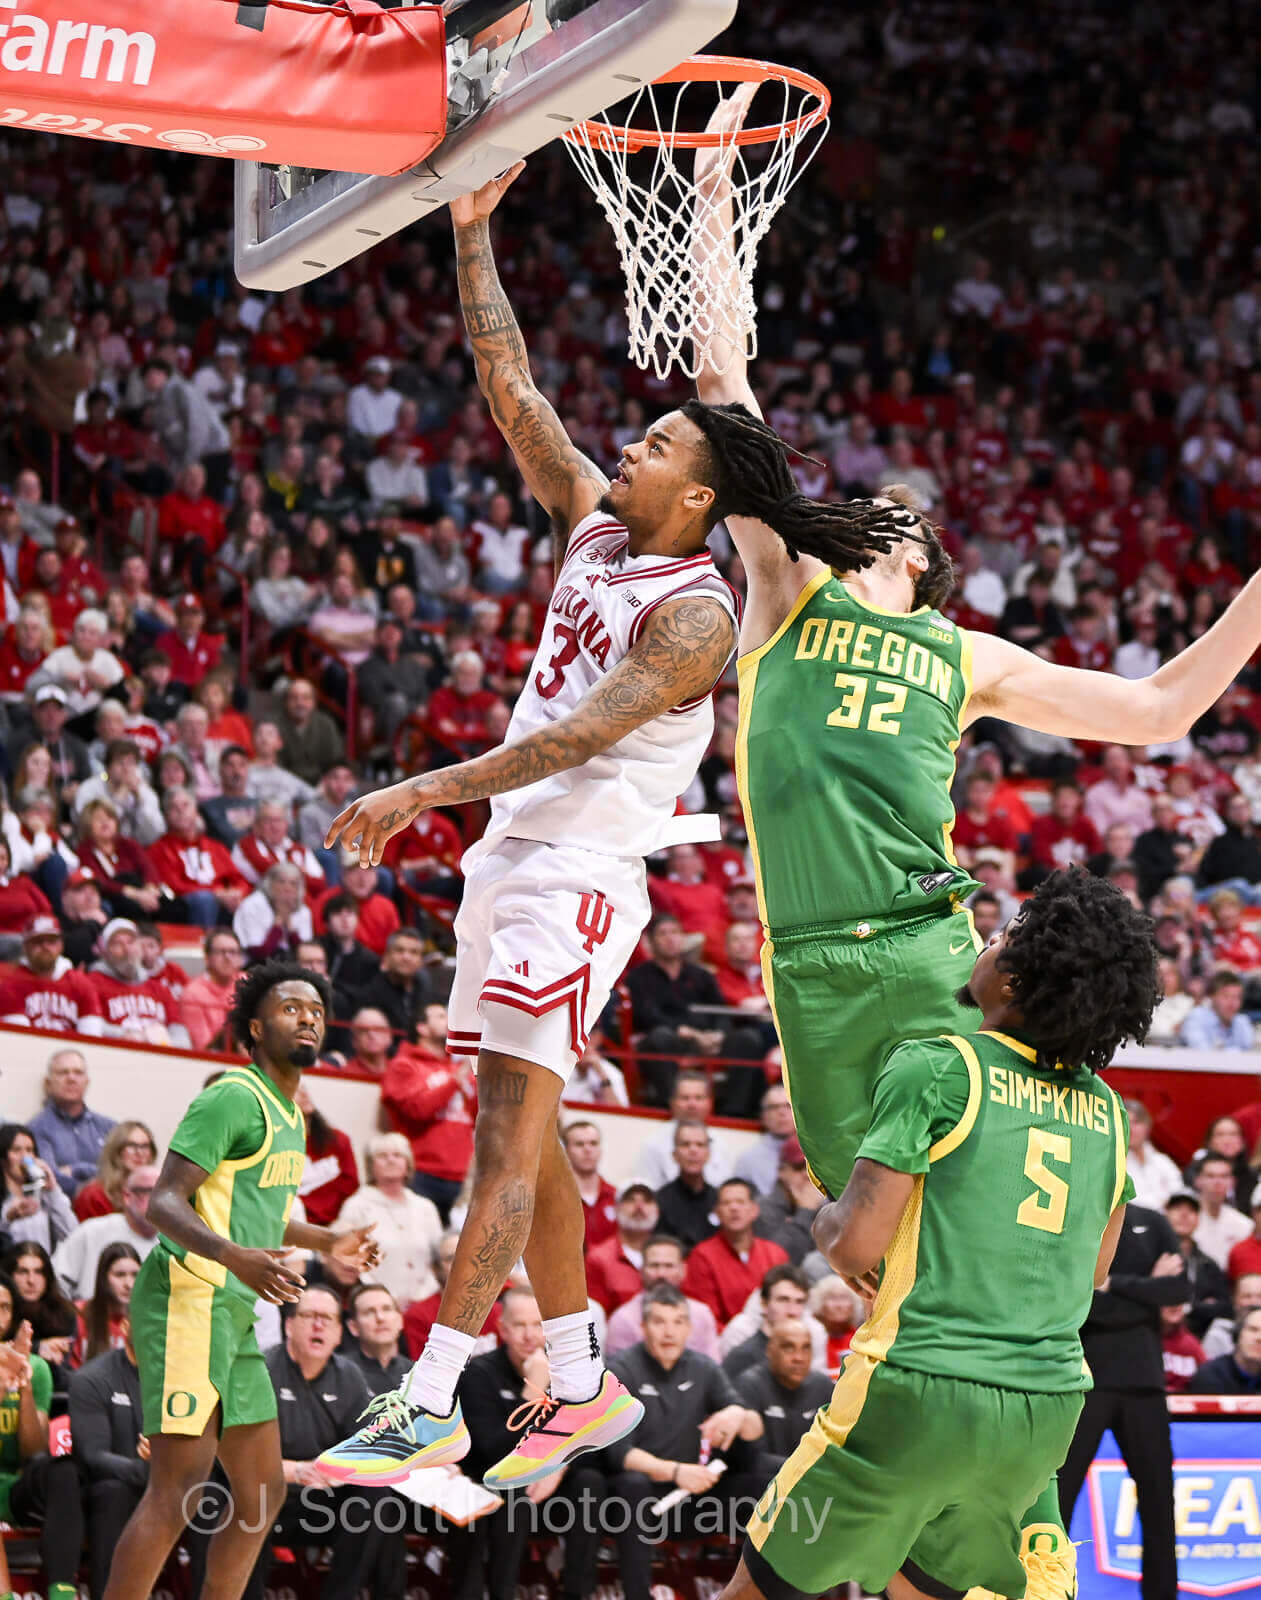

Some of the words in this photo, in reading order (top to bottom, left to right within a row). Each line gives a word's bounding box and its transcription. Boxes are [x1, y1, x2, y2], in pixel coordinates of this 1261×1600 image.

[535, 623, 580, 700] 3
[794, 618, 954, 702] OREGON
[826, 672, 909, 736] 32
[989, 1065, 1110, 1136] SIMPKINS
[1016, 1126, 1072, 1235] 5
